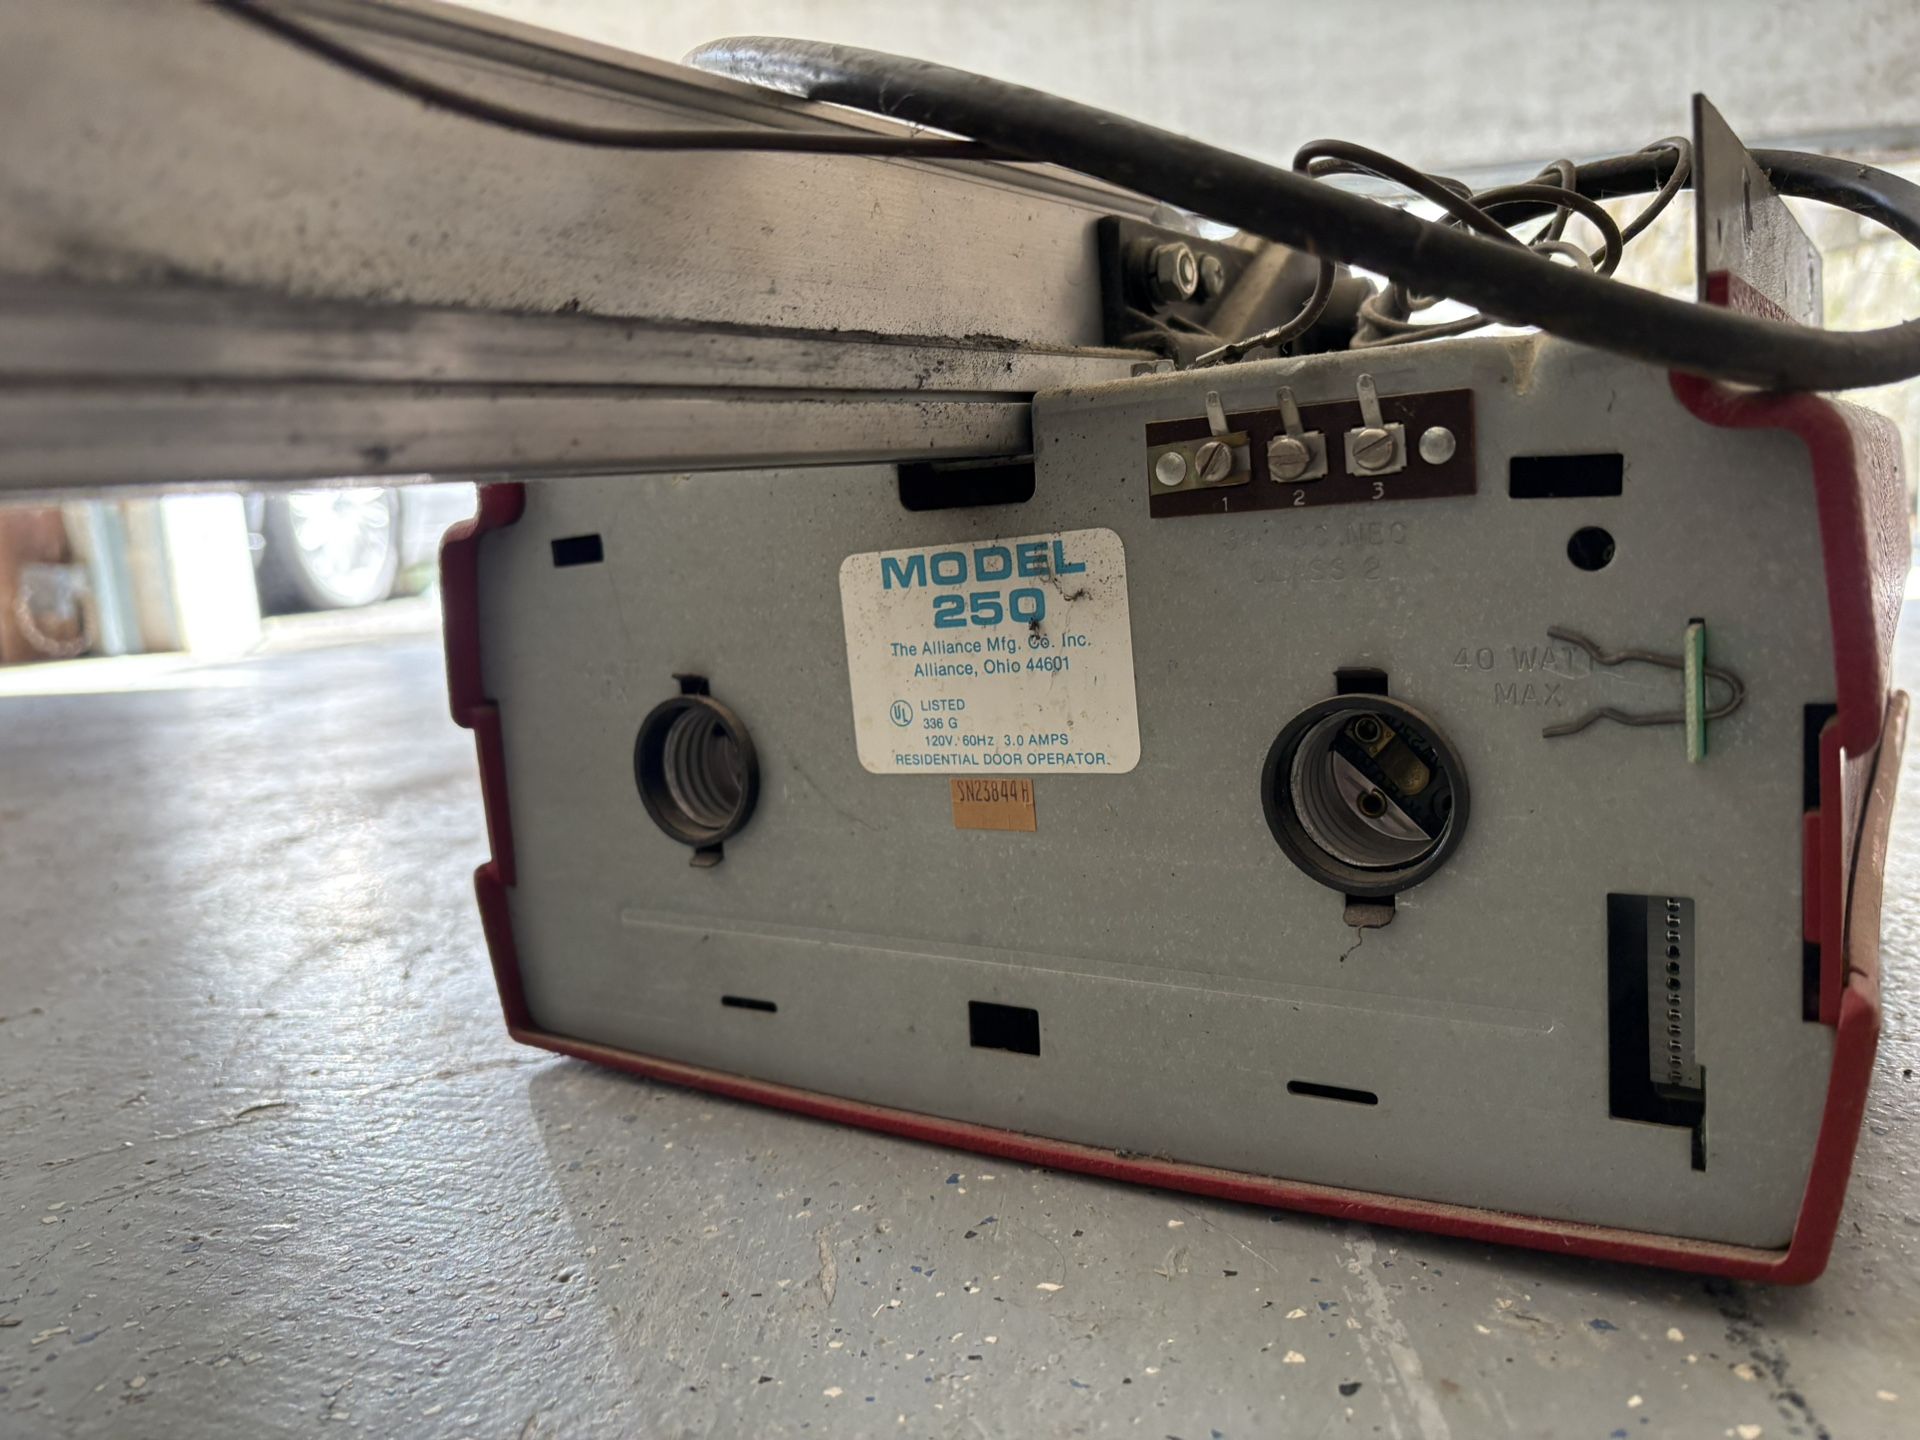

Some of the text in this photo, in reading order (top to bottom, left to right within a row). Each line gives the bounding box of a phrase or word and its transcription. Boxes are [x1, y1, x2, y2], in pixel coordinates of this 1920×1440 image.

[1221, 481, 1385, 513] 1 2 3
[880, 540, 1086, 590] MODEL
[933, 587, 1046, 629] 250
[891, 633, 1092, 658] The Alliance Mfg. Co. Inc.
[914, 656, 1071, 678] Alliance, Ohio 44601
[1453, 647, 1495, 672] 40
[920, 698, 966, 712] LISTED
[1494, 682, 1562, 708] MAX
[923, 717, 959, 730] 336 G
[962, 735, 995, 747] 60Hz
[1003, 735, 1024, 747] 3.0
[1028, 733, 1070, 747] AMPS
[895, 752, 980, 766] RESIDENTIAL
[983, 752, 1023, 766] DOOR
